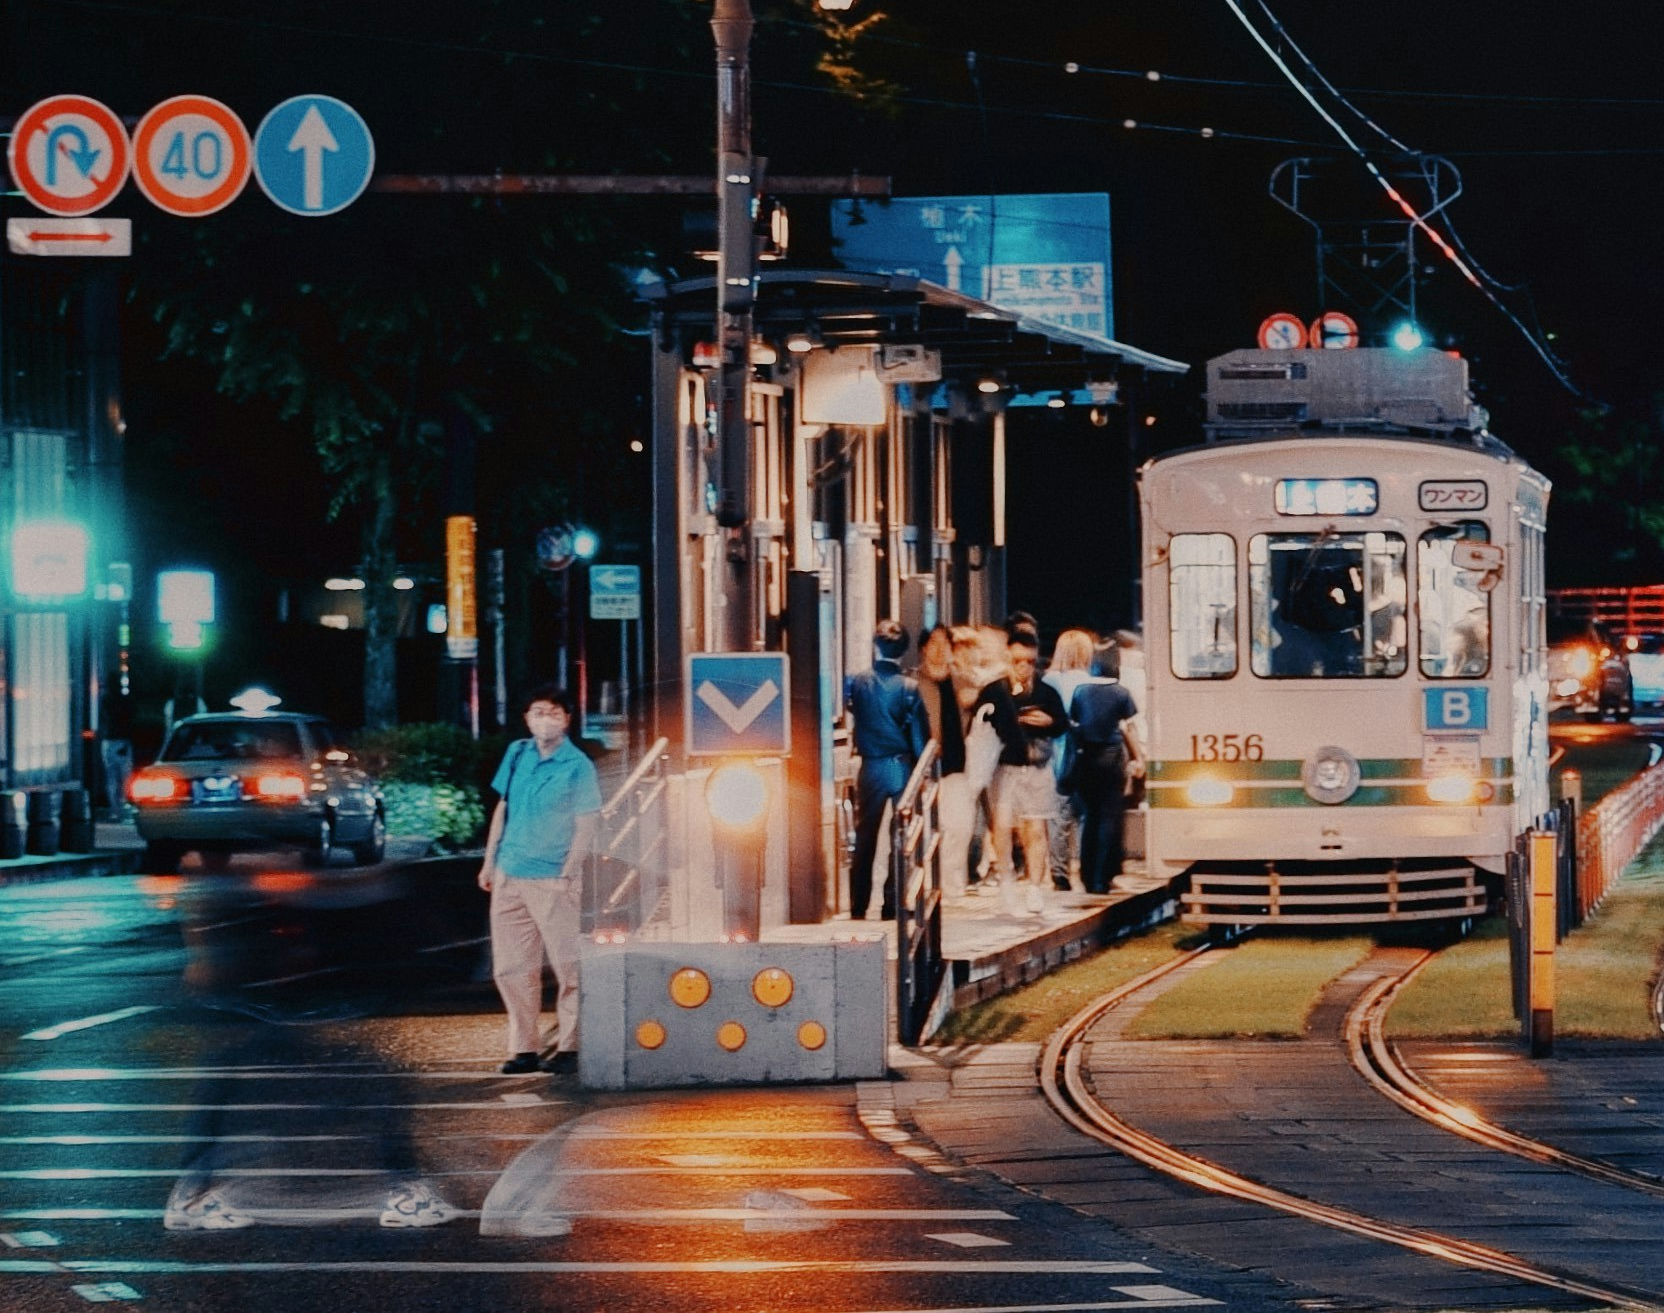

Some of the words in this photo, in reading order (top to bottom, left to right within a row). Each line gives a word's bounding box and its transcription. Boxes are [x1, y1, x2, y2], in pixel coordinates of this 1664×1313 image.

[161, 132, 221, 180] 40
[1425, 489, 1482, 503] ワンマン
[1442, 692, 1472, 726] B
[1190, 734, 1264, 762] 1356
